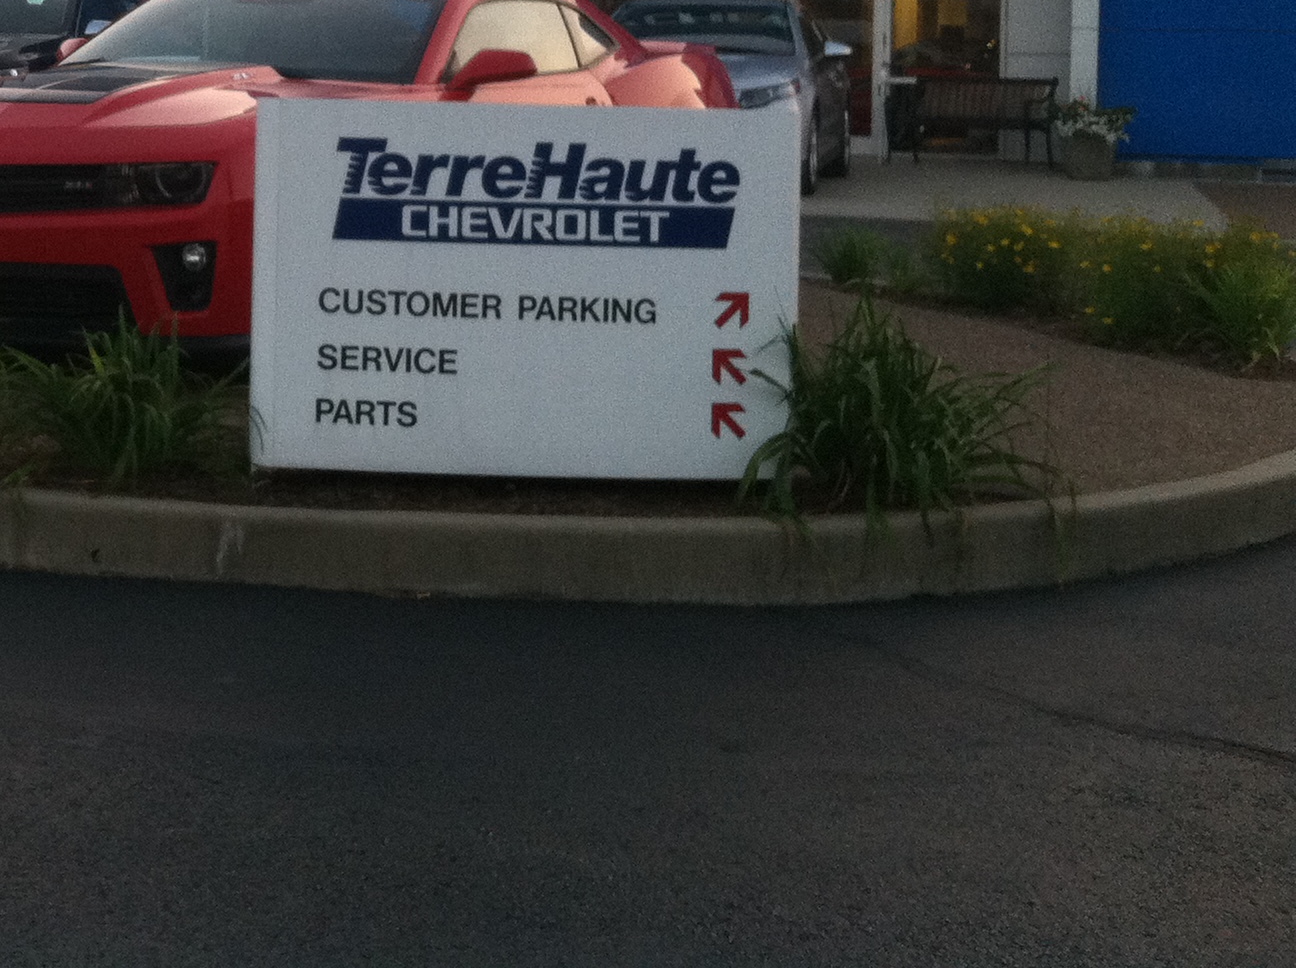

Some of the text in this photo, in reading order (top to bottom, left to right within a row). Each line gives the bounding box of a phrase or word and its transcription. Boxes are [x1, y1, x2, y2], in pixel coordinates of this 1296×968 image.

[401, 204, 671, 244] CHEVROLET
[317, 286, 657, 325] CUSTOMER PARKING
[316, 343, 458, 375] SERVICE
[314, 397, 418, 428] PARTS
